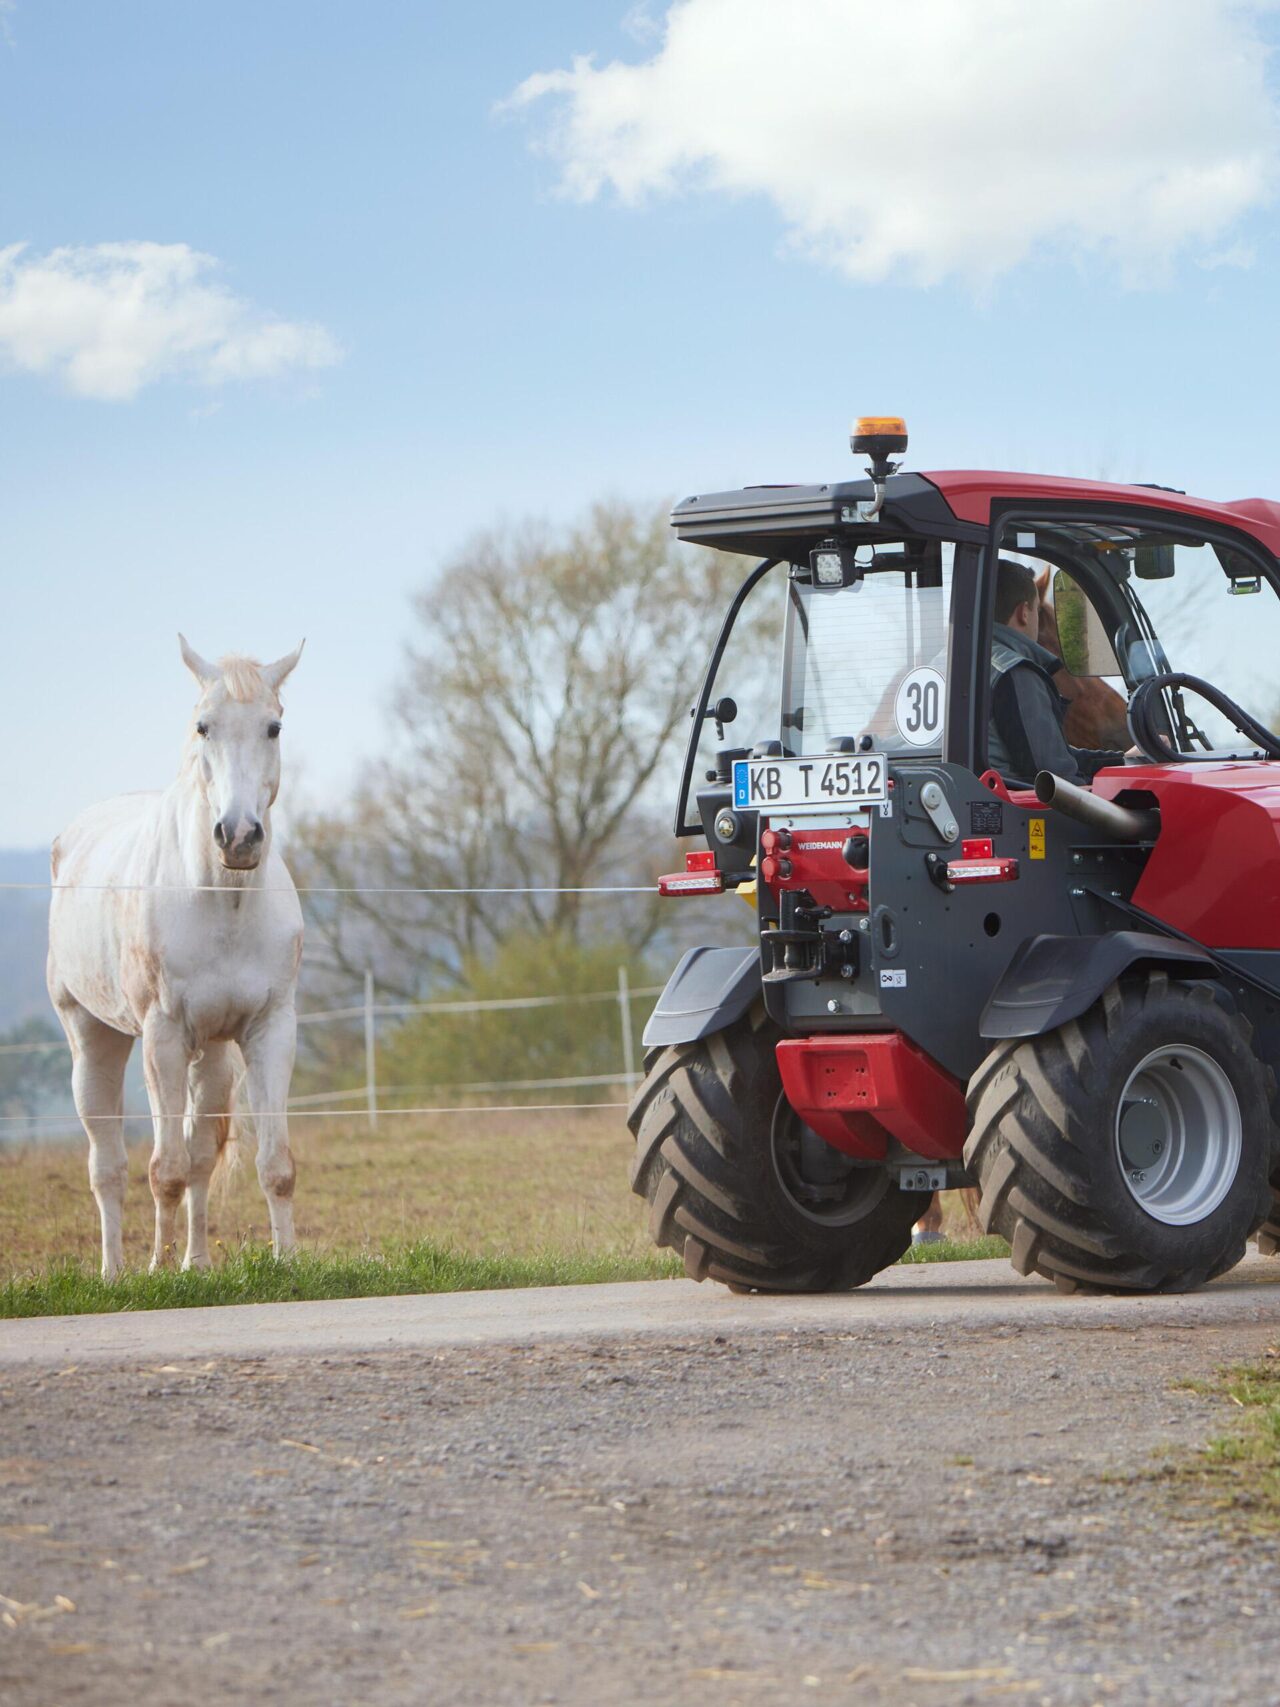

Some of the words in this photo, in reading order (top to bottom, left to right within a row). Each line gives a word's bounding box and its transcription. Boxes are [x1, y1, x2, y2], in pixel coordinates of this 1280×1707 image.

[906, 681, 939, 732] 30
[750, 767, 782, 800] KB
[799, 764, 813, 797] T
[821, 761, 881, 796] 4512
[739, 789, 746, 800] D
[798, 841, 843, 850] WEIDEMANN
